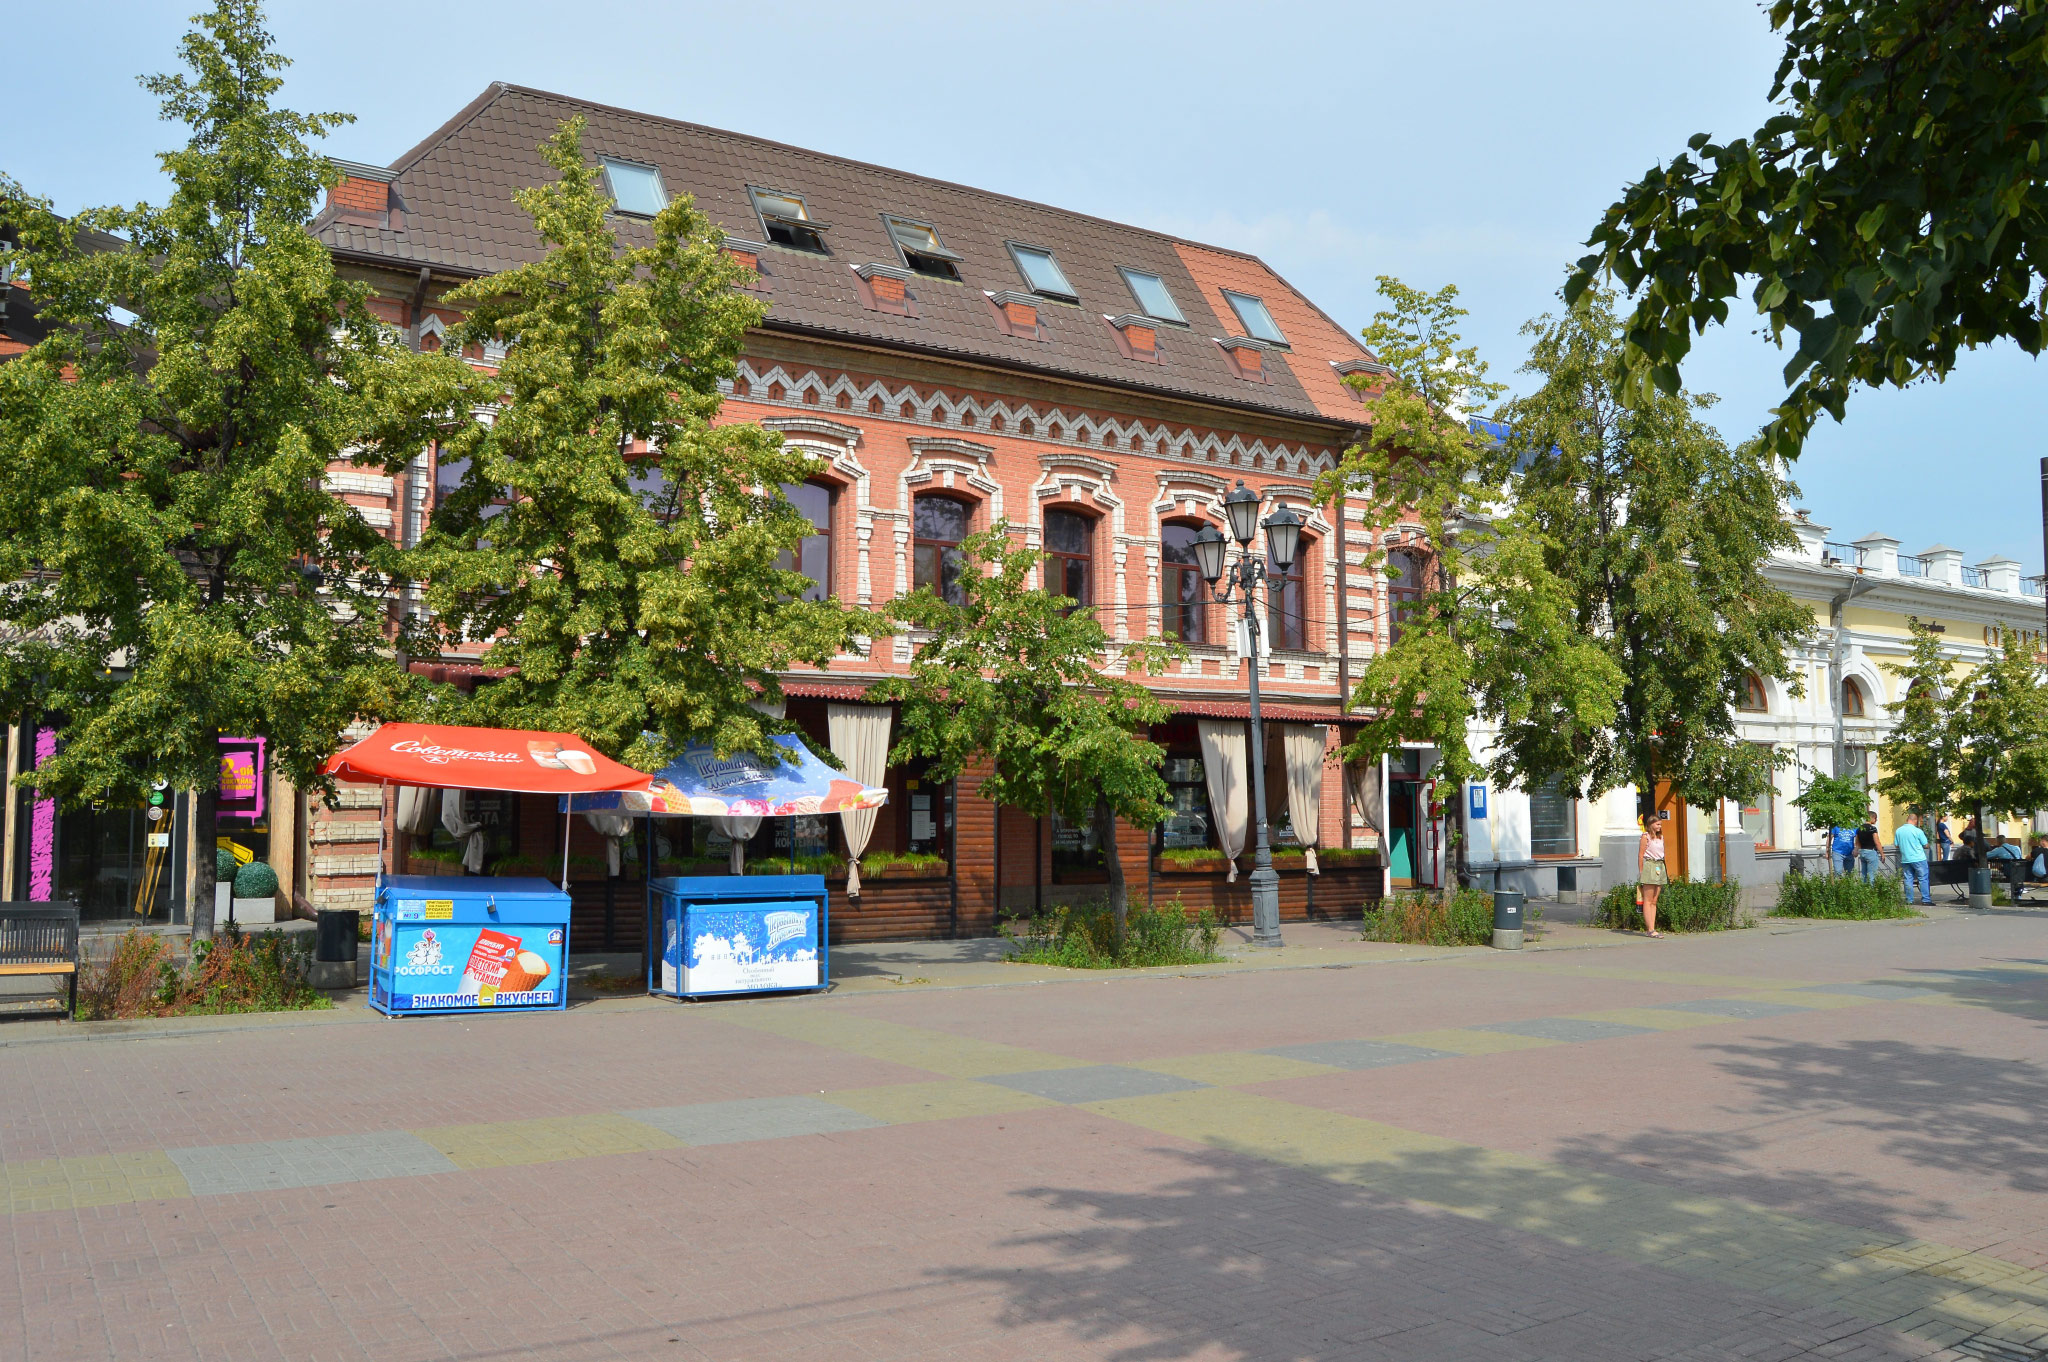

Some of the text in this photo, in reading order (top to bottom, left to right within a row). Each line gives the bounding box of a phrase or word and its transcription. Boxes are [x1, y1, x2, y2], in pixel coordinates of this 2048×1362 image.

[390, 740, 521, 759] Советский
[394, 965, 454, 976] РОСФРОСТ
[413, 993, 479, 1008] ЗНАКОМОЕ
[495, 991, 554, 1006] ВКУСНЕЕ!
